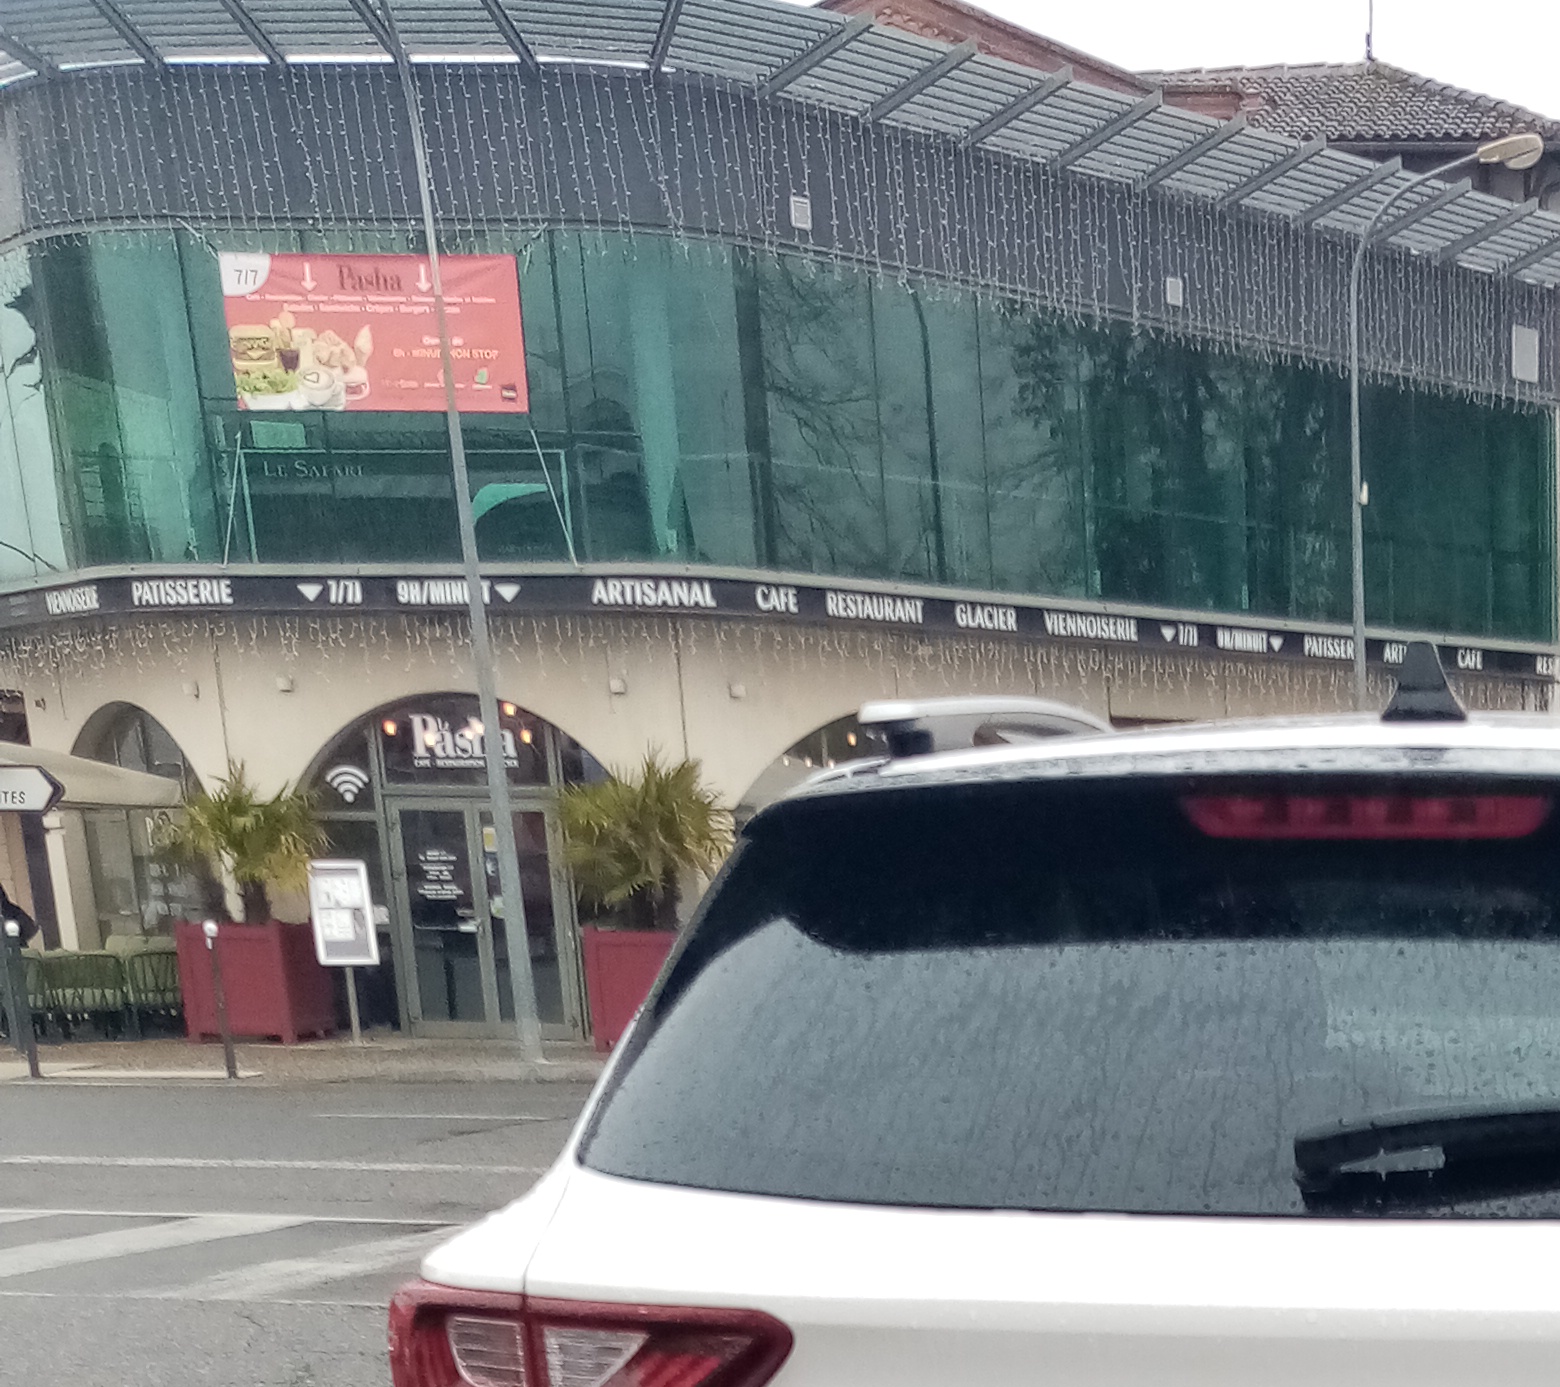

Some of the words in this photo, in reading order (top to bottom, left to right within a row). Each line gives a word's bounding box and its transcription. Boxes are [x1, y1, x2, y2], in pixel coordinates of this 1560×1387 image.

[131, 578, 234, 607] PATISSERIE
[591, 578, 718, 609] ARTISANAL
[755, 584, 799, 614] CAFE
[825, 589, 925, 625] RESTAURANT
[954, 603, 1019, 633] GLACIER
[1043, 609, 1140, 643] VIENNOISERIE
[0, 790, 26, 804] TES
